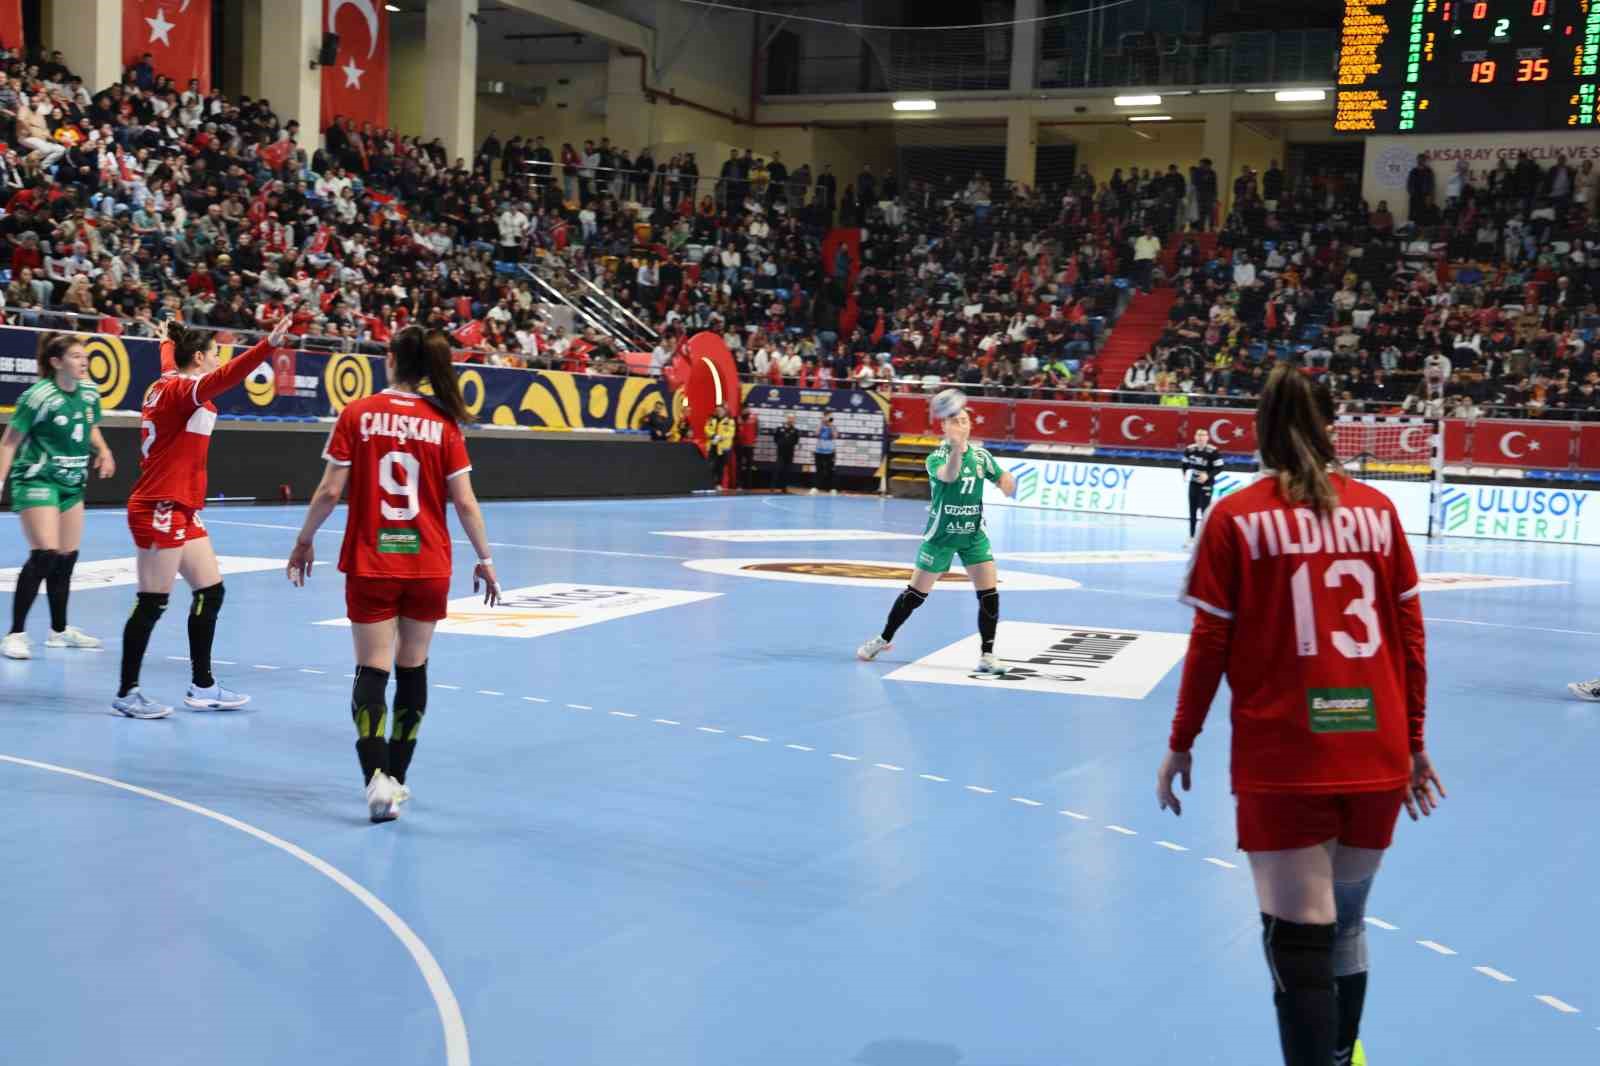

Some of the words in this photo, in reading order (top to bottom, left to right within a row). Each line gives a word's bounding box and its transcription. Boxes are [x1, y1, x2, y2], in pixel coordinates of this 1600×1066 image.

[1472, 3, 1487, 19] 0
[1494, 19, 1510, 36] 2
[1471, 61, 1496, 83] 19
[1517, 59, 1549, 81] 35
[1423, 148, 1491, 160] AKSARAY
[1569, 146, 1587, 159] VE
[70, 423, 84, 442] 4
[360, 412, 444, 445] ÇALIŞKAN
[378, 451, 420, 520] 9
[960, 477, 976, 494] 77
[1043, 462, 1134, 489] ULUSOY
[1478, 488, 1587, 517] ULUSOY
[1233, 506, 1393, 560] YILDIRIM
[1291, 559, 1382, 659] 13
